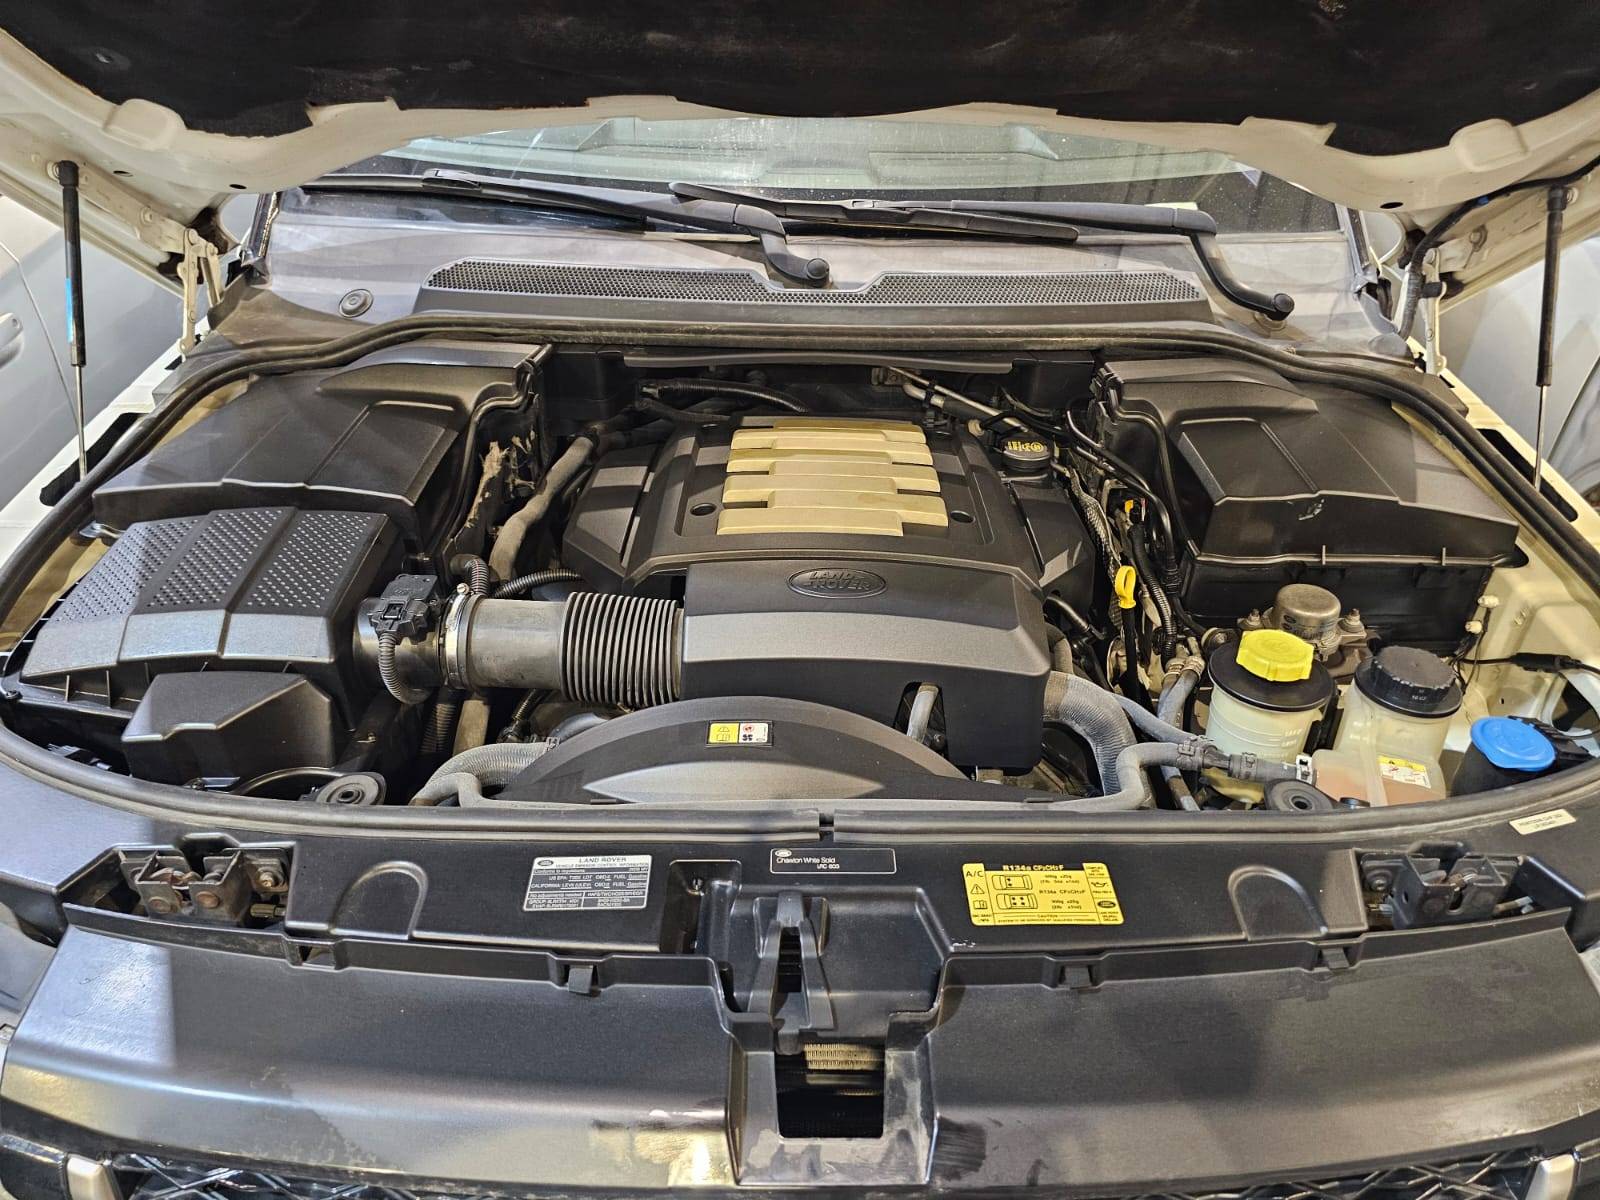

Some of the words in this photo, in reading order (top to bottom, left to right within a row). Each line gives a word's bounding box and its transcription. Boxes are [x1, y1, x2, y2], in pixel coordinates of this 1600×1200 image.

[809, 571, 854, 581] LAND
[812, 580, 871, 591] ROVER
[803, 856, 820, 864] White
[821, 856, 836, 864] Solid
[965, 870, 984, 878] A/C
